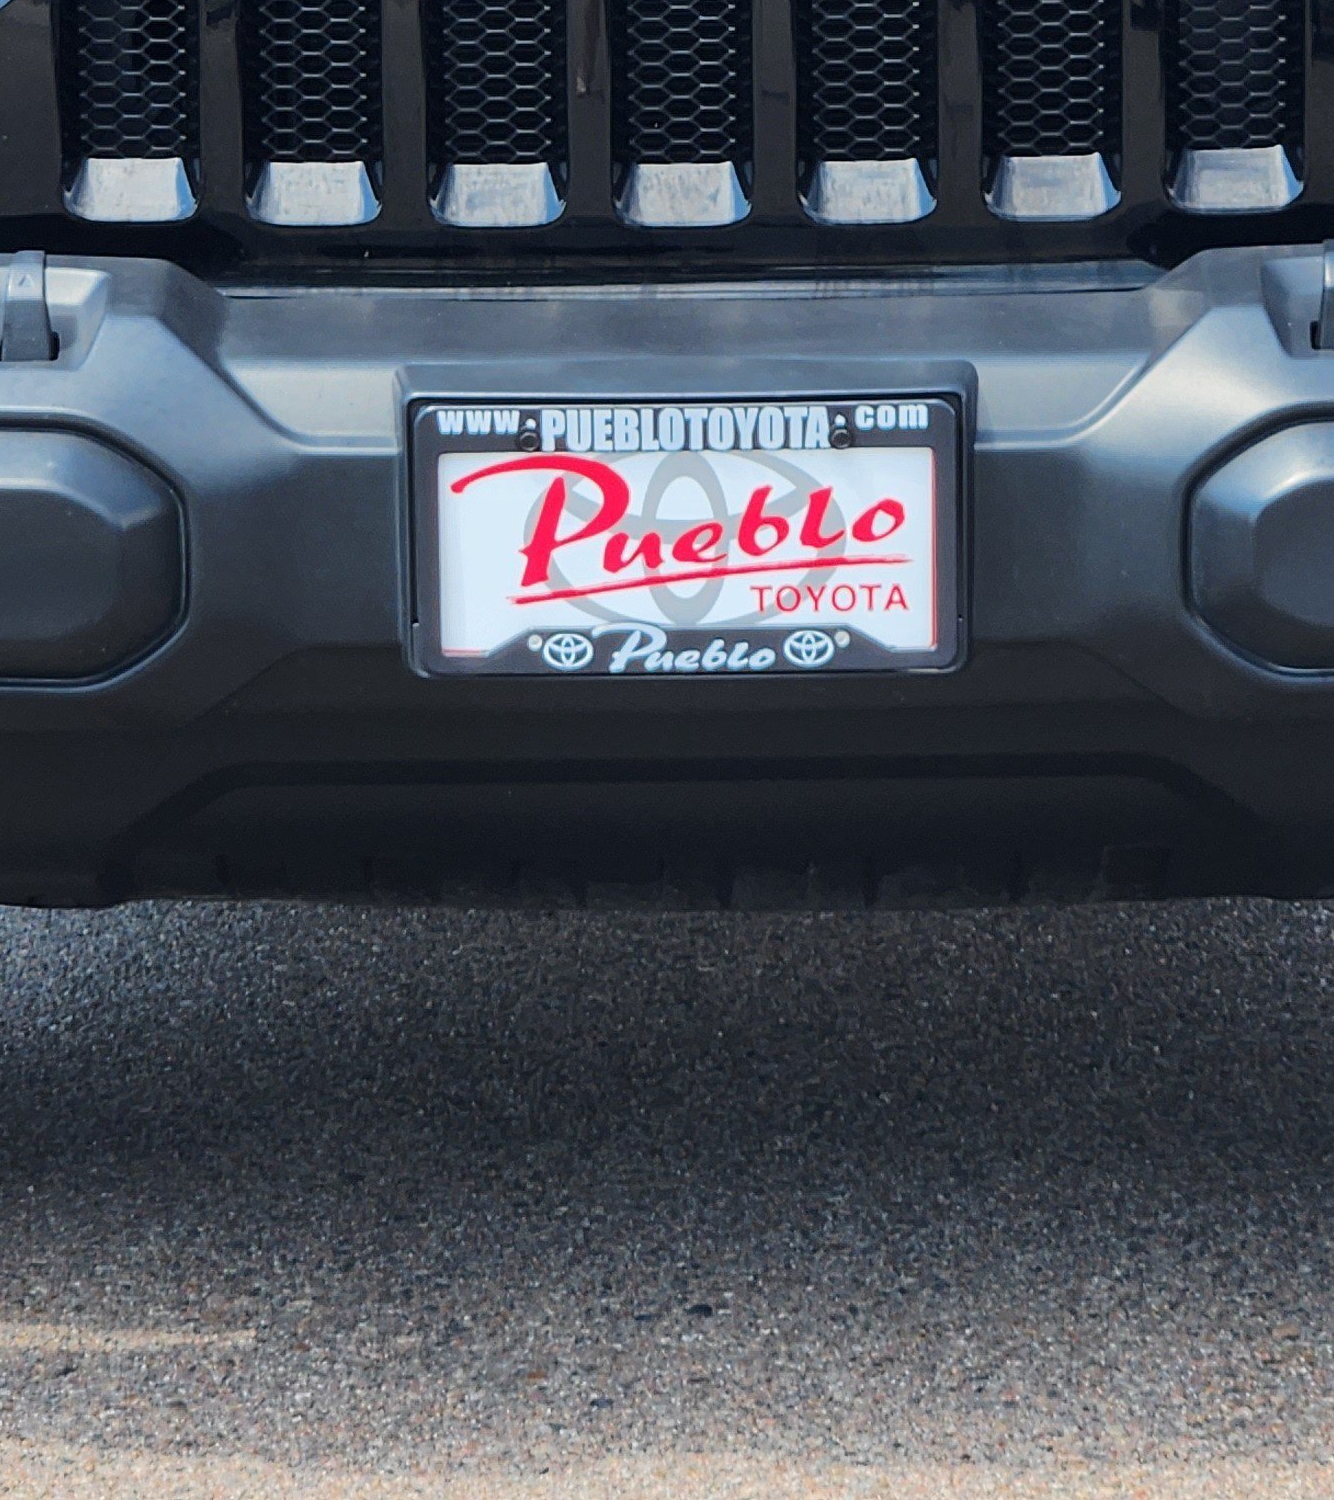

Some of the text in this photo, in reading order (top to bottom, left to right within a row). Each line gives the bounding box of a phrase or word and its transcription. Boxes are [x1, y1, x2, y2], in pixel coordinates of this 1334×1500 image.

[450, 455, 905, 587] Pueblo
[749, 583, 910, 614] TOYOTA
[591, 622, 776, 673] Pueblo
